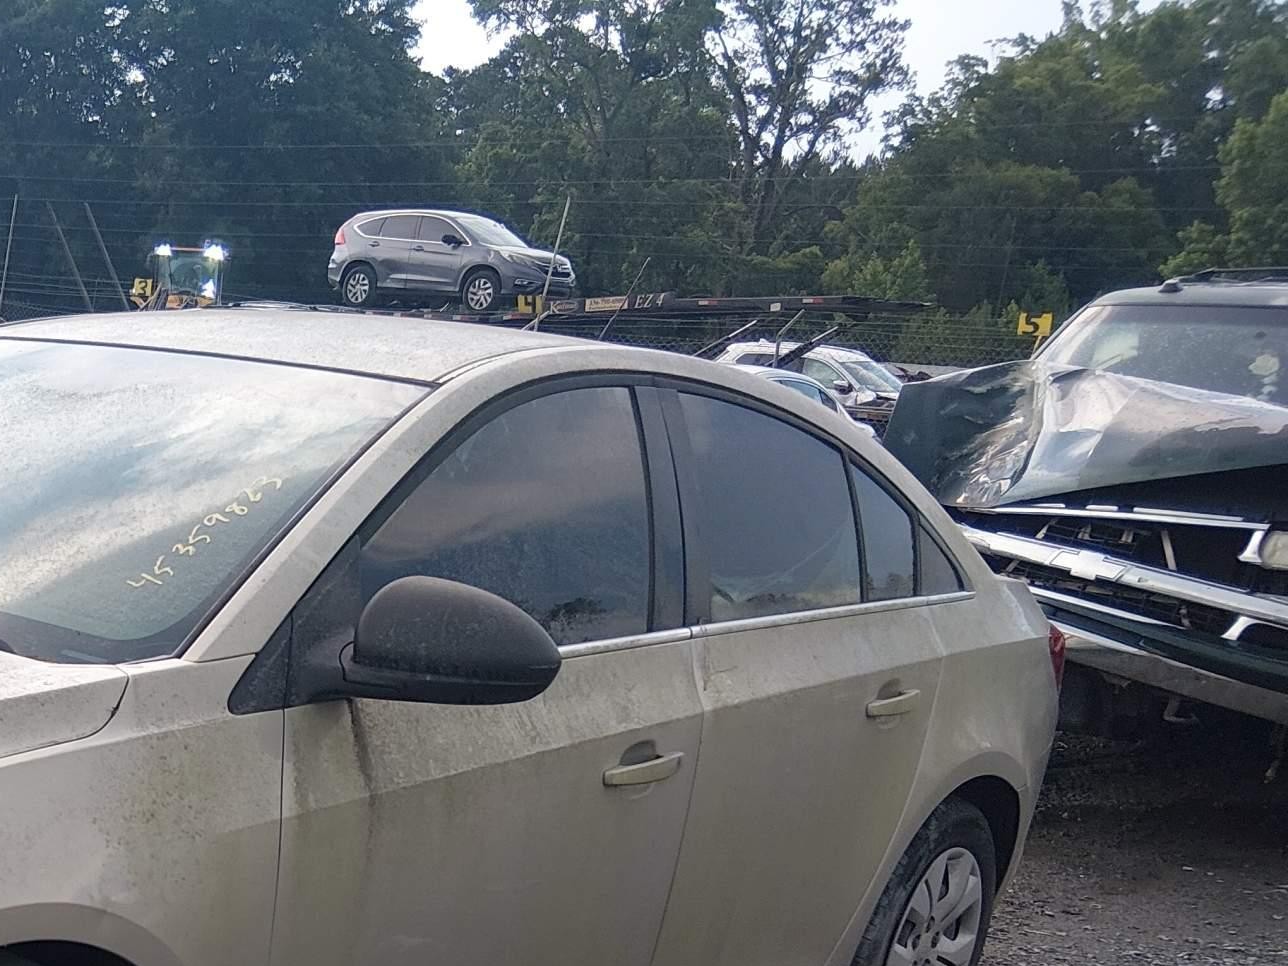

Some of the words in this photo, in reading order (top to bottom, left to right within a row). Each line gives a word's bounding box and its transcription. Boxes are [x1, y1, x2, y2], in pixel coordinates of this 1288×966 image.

[137, 280, 148, 296] 3
[634, 293, 654, 309] EZ
[655, 292, 666, 307] 4
[1021, 312, 1042, 334] 5
